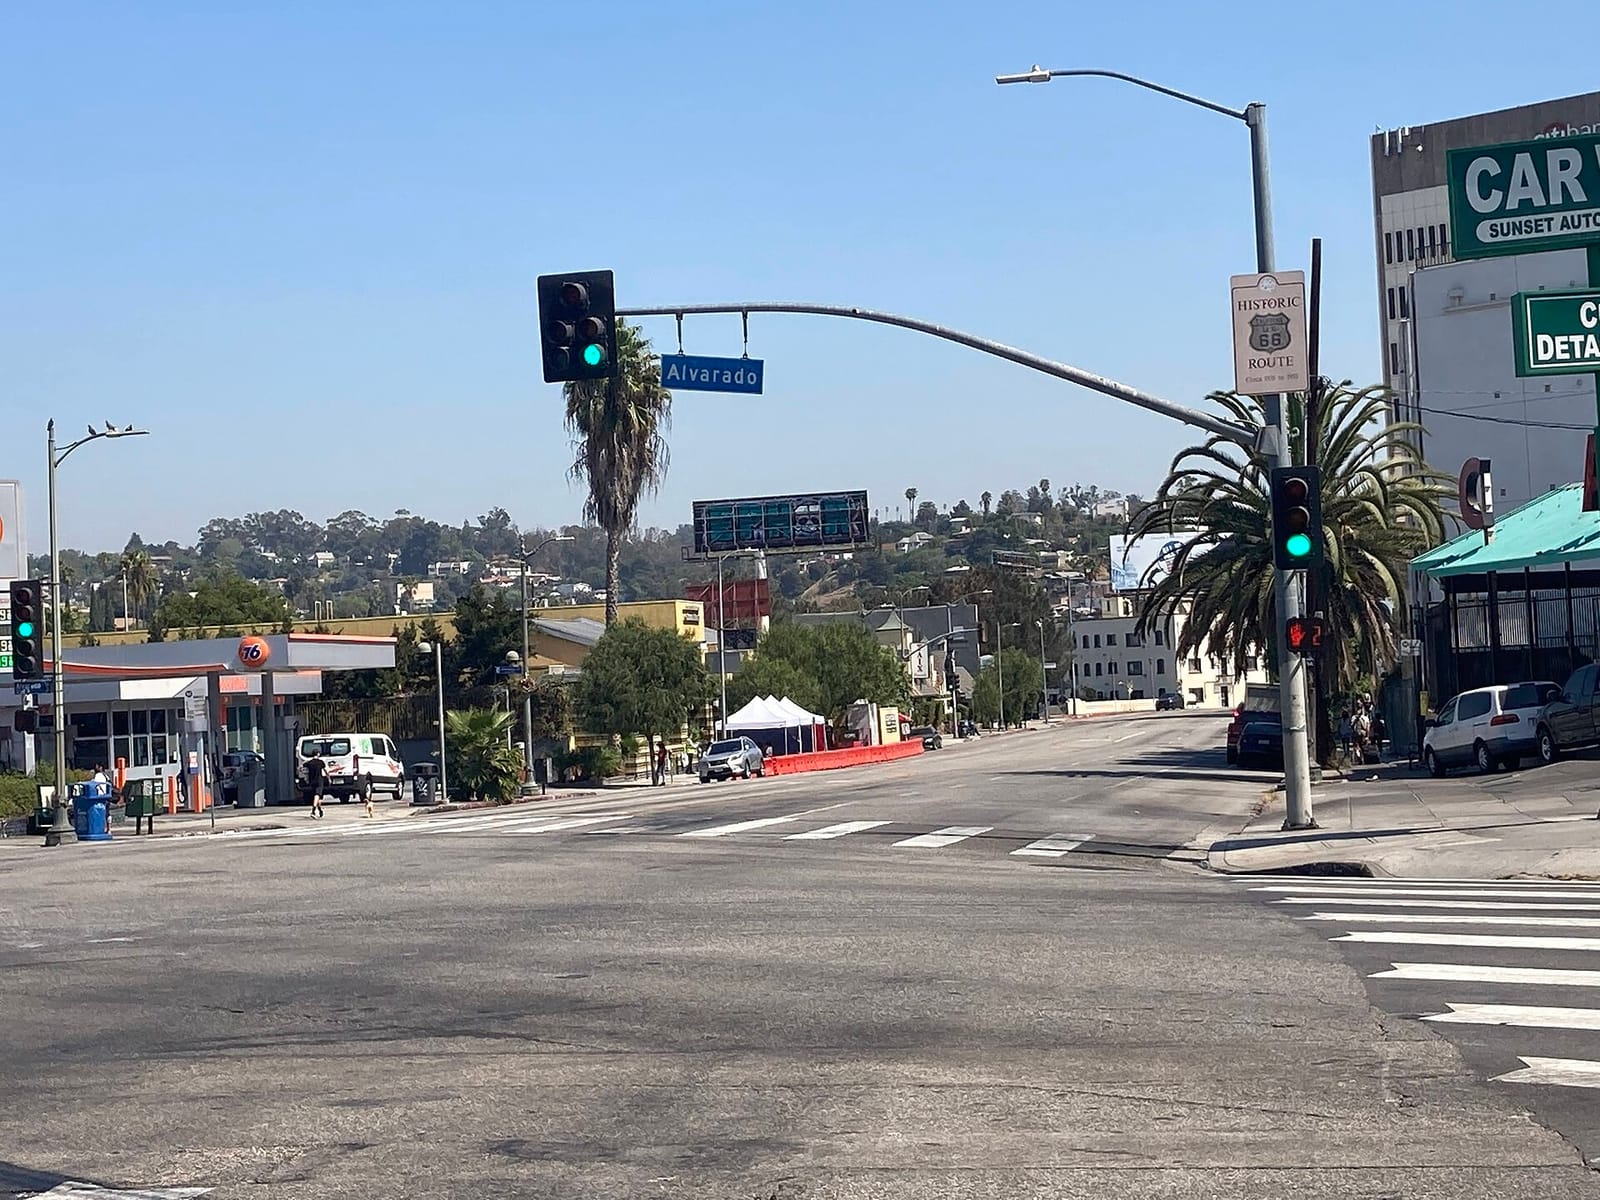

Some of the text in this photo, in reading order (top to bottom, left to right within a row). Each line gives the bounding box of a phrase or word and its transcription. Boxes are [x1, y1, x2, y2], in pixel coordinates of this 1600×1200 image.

[1465, 147, 1588, 213] CAR
[1489, 211, 1600, 238] SUNSET AUTO
[1238, 297, 1301, 311] HISTORIC
[1580, 301, 1600, 328] C
[1259, 333, 1281, 347] 66
[1536, 334, 1600, 360] DETA
[1248, 356, 1294, 369] ROUTE
[667, 364, 757, 384] Alvarado
[1312, 625, 1321, 645] 2
[243, 644, 262, 660] 76
